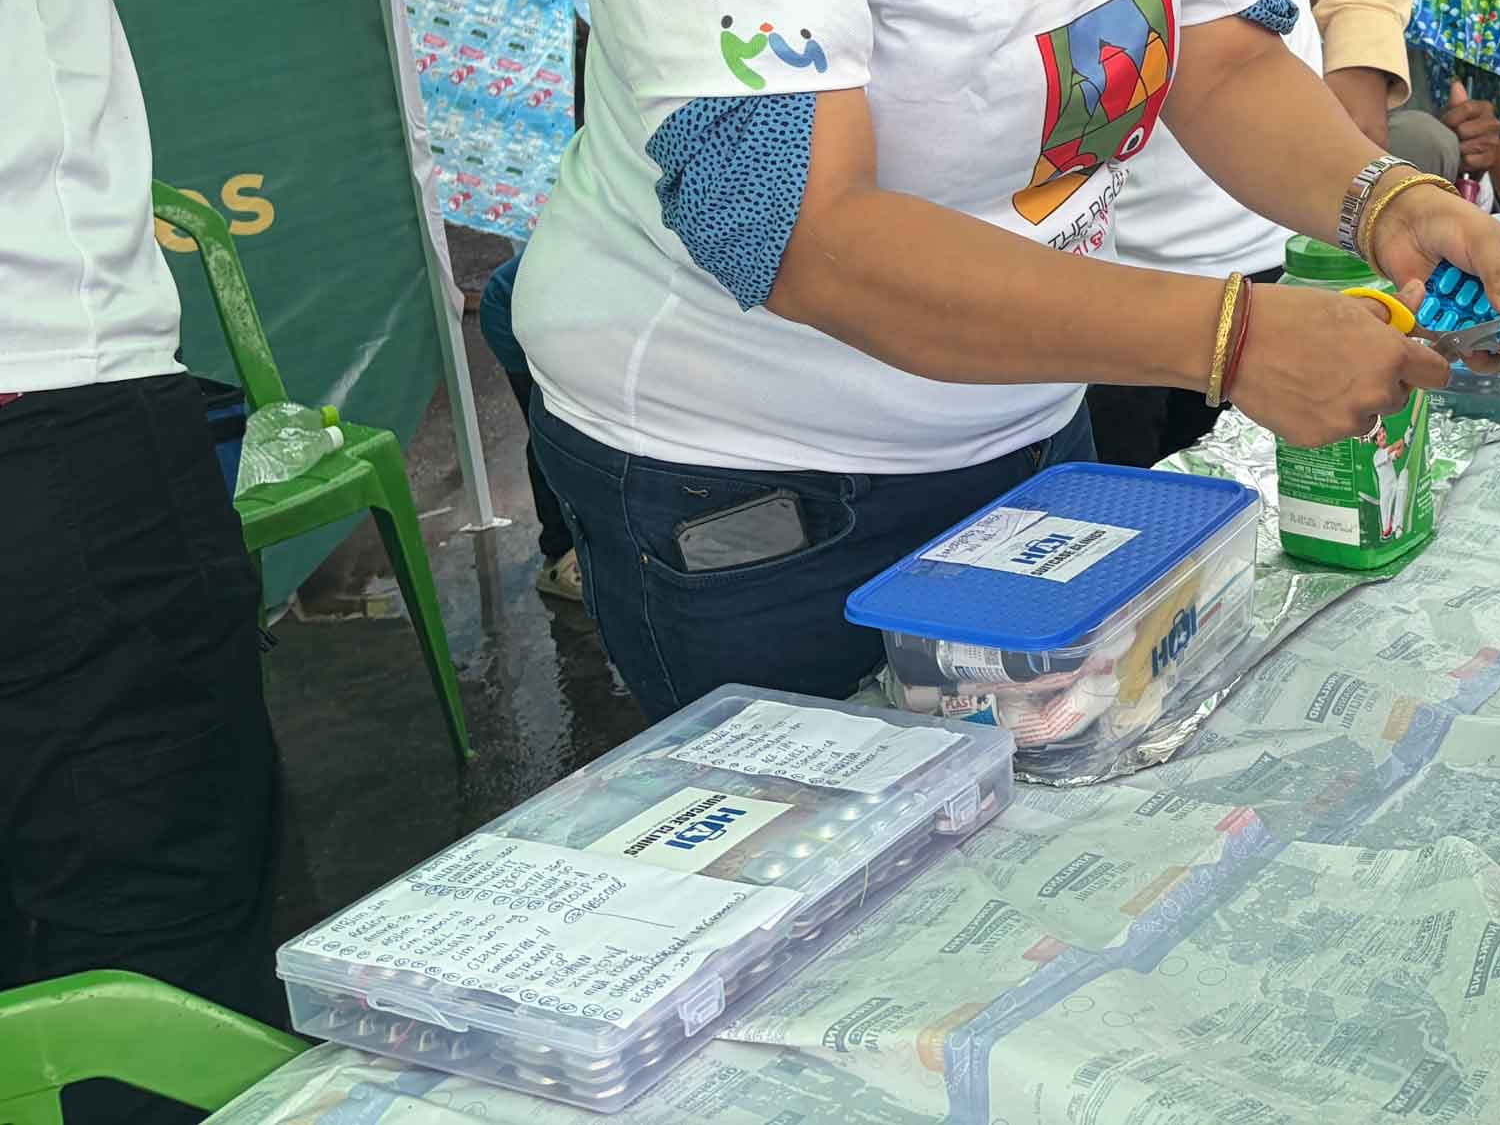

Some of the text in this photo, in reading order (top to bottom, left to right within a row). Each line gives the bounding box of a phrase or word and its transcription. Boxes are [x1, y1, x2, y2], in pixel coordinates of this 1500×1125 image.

[1030, 550, 1074, 576] SUITCASE
[623, 794, 728, 858] SUITCASE CLINICS
